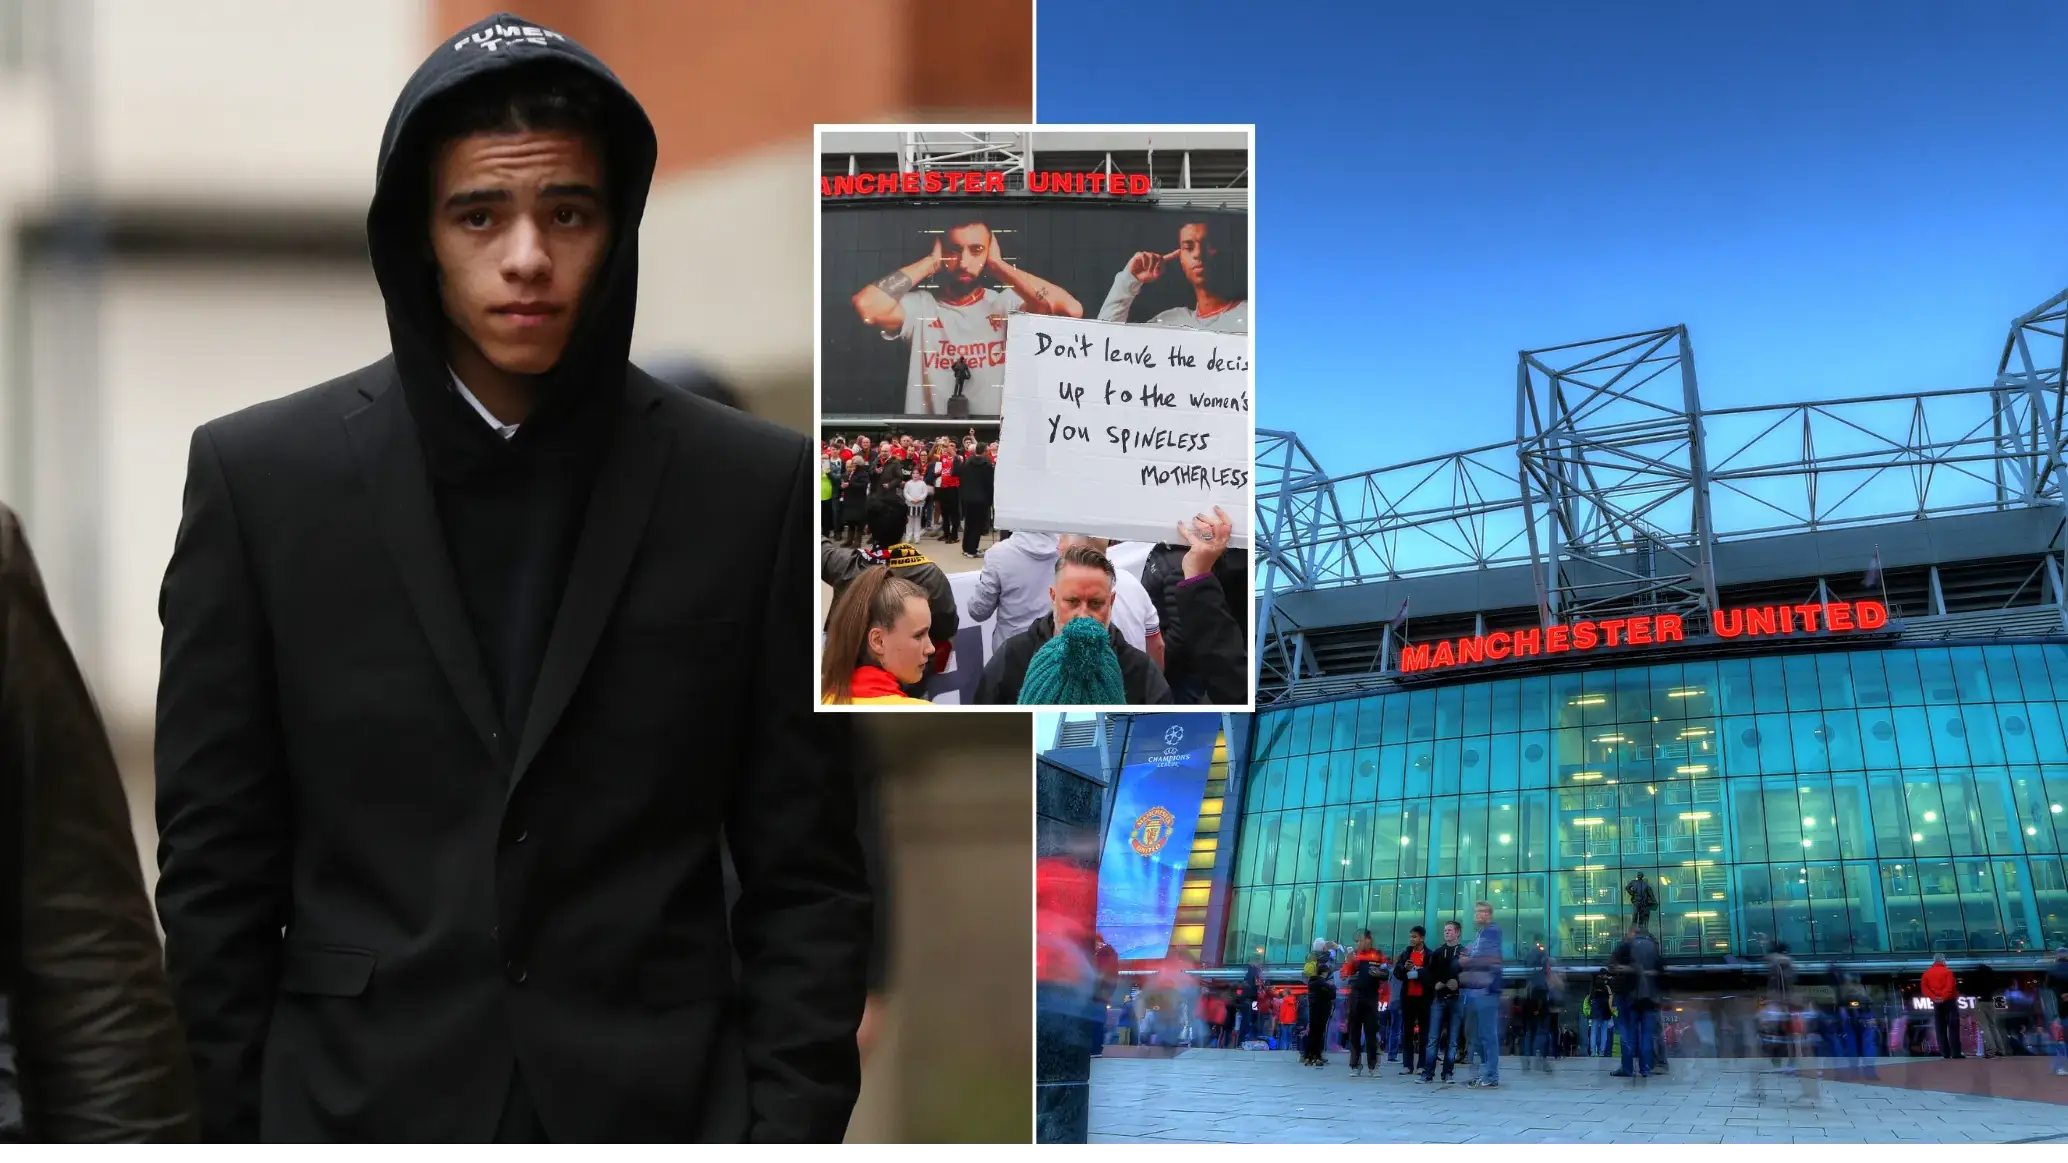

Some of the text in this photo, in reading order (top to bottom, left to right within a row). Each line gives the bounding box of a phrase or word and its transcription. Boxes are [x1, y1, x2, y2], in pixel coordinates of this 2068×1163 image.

[1027, 171, 1151, 195] UNITED
[938, 340, 986, 356] Team
[1034, 332, 1093, 358] Don't
[1105, 337, 1156, 368] leave
[1168, 345, 1196, 368] the
[923, 352, 987, 370] Vieer
[1104, 379, 1133, 405] to
[1140, 383, 1176, 408] the
[1106, 426, 1210, 453] SPINELESS
[891, 556, 925, 565] AUGUST
[1400, 601, 1888, 672] MANCHESTER UNITED
[1148, 754, 1191, 763] CHAMPIONS
